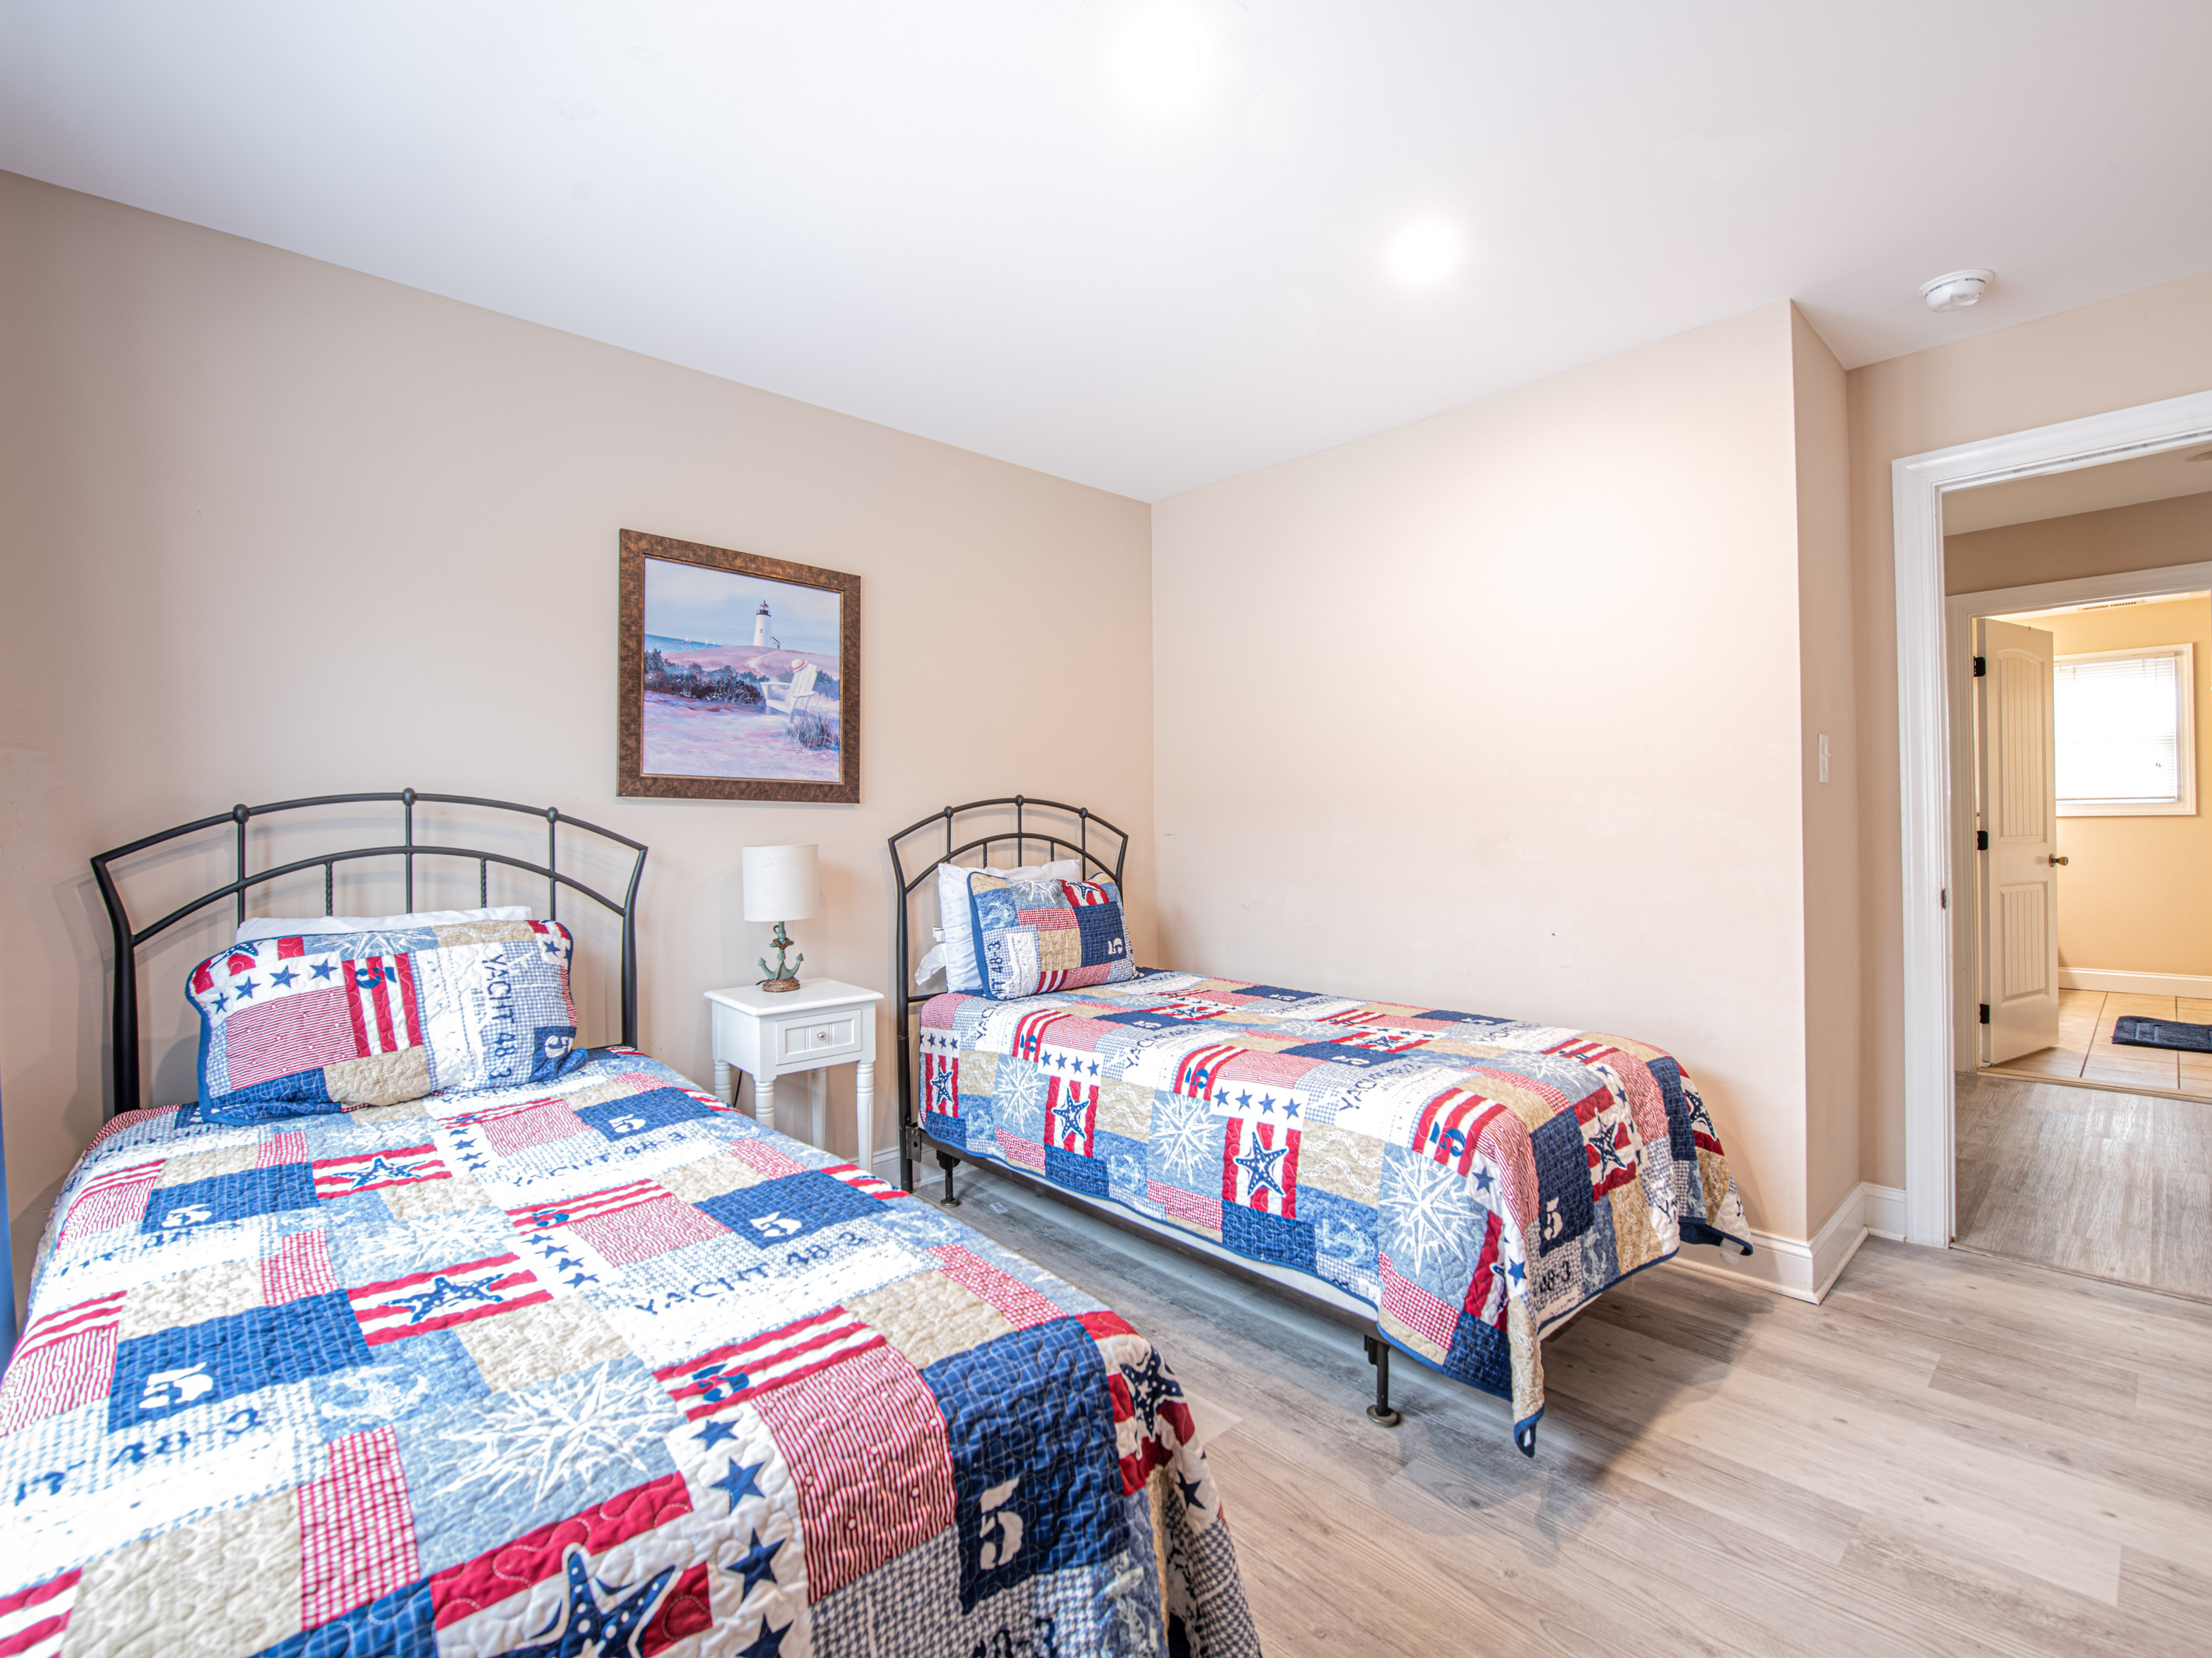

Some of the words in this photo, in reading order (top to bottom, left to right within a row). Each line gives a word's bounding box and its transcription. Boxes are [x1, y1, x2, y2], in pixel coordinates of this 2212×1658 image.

[988, 938, 1004, 973] 48-3
[1108, 937, 1123, 955] 5
[481, 954, 515, 1024] YACHT
[1428, 1121, 1467, 1157] 5
[1543, 1196, 1564, 1241] 5
[979, 1476, 1024, 1571] 5
